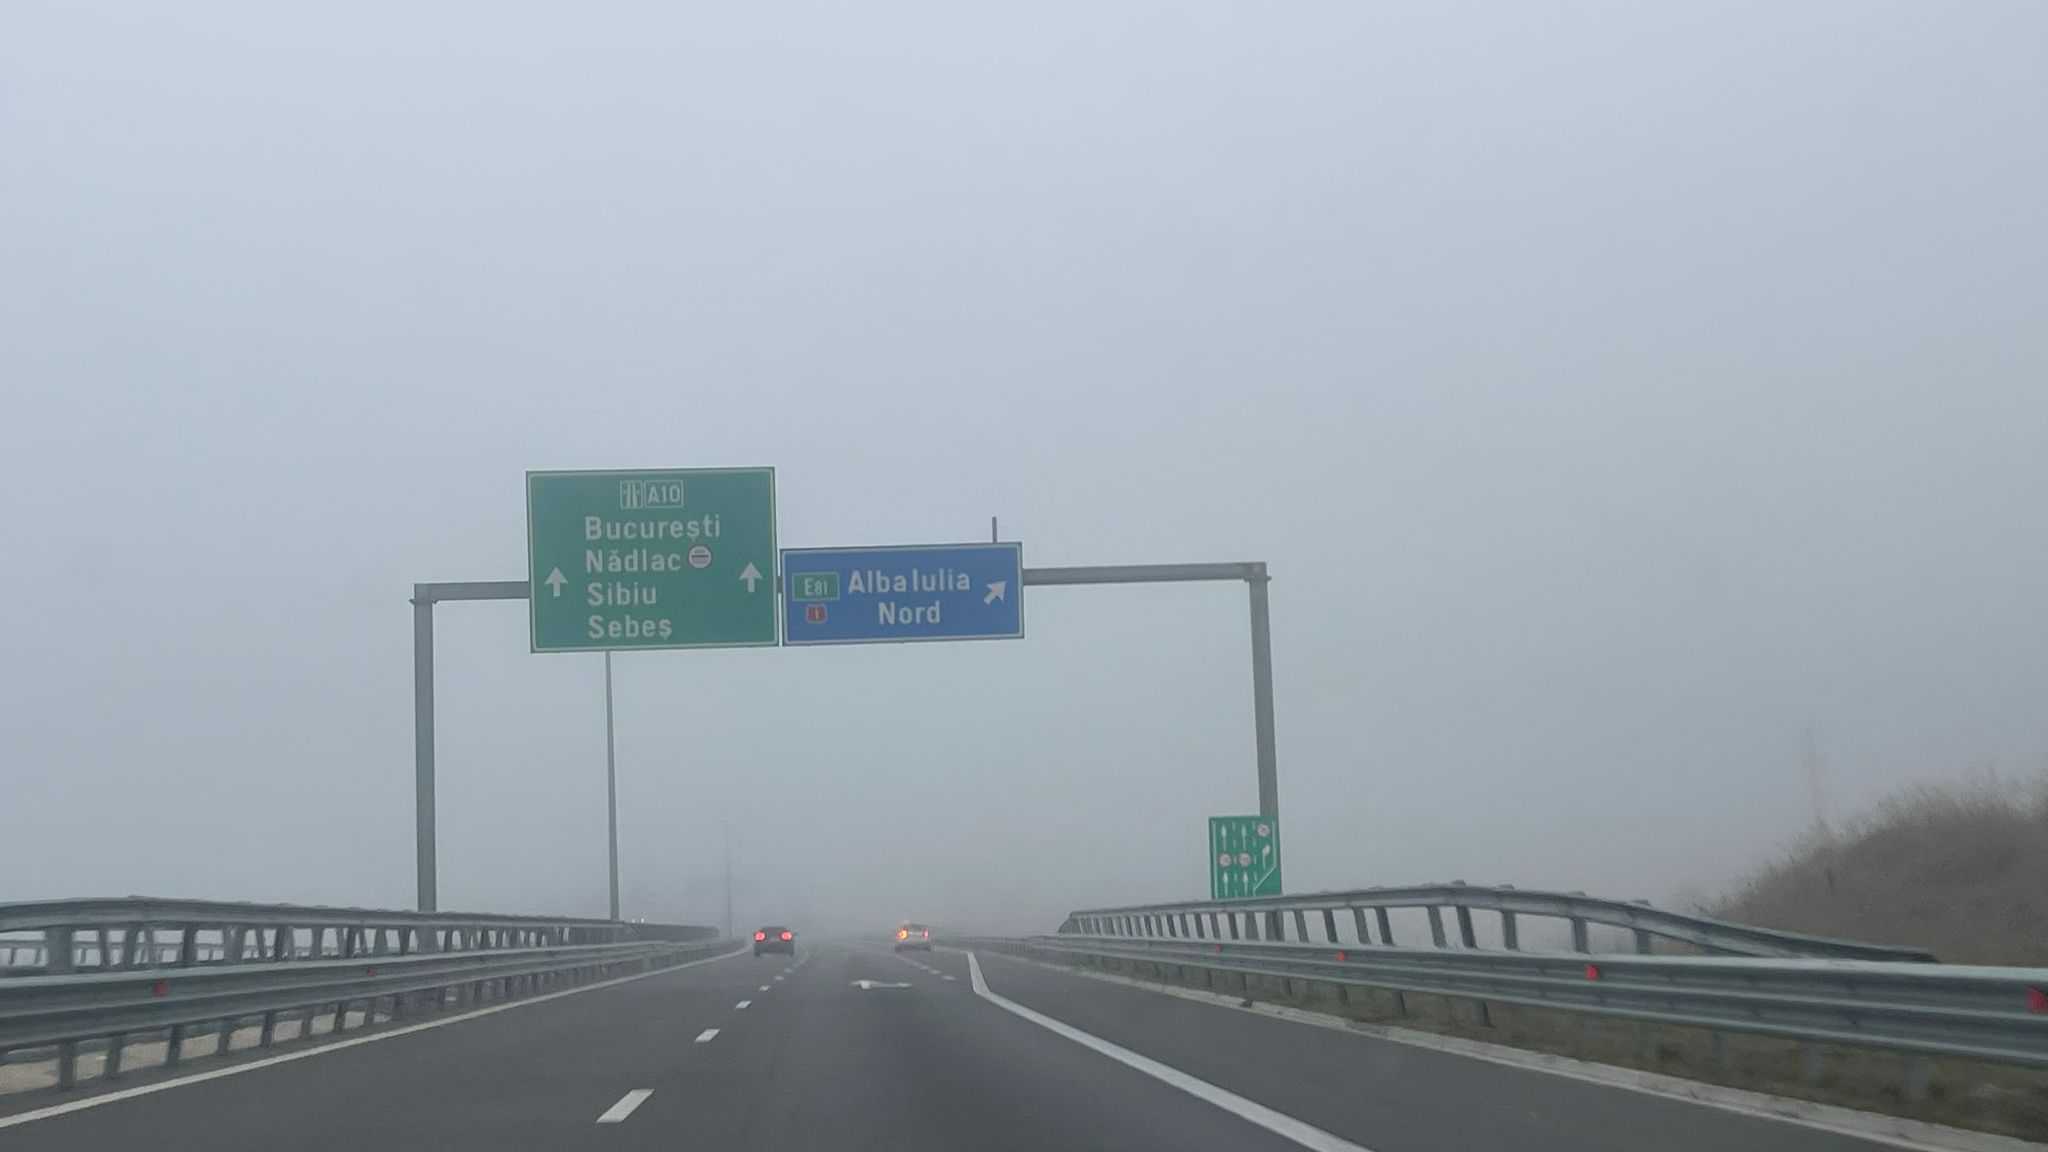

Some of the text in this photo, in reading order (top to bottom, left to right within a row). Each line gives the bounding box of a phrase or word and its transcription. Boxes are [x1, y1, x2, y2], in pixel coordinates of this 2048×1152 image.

[647, 485, 681, 503] A10
[585, 514, 721, 541] București
[586, 548, 682, 573] Nădlac
[804, 577, 828, 596] E81
[848, 568, 970, 594] Alba Iulia
[587, 582, 657, 606] Sibiu
[878, 601, 941, 625] Nord
[588, 615, 672, 641] Sebeș
